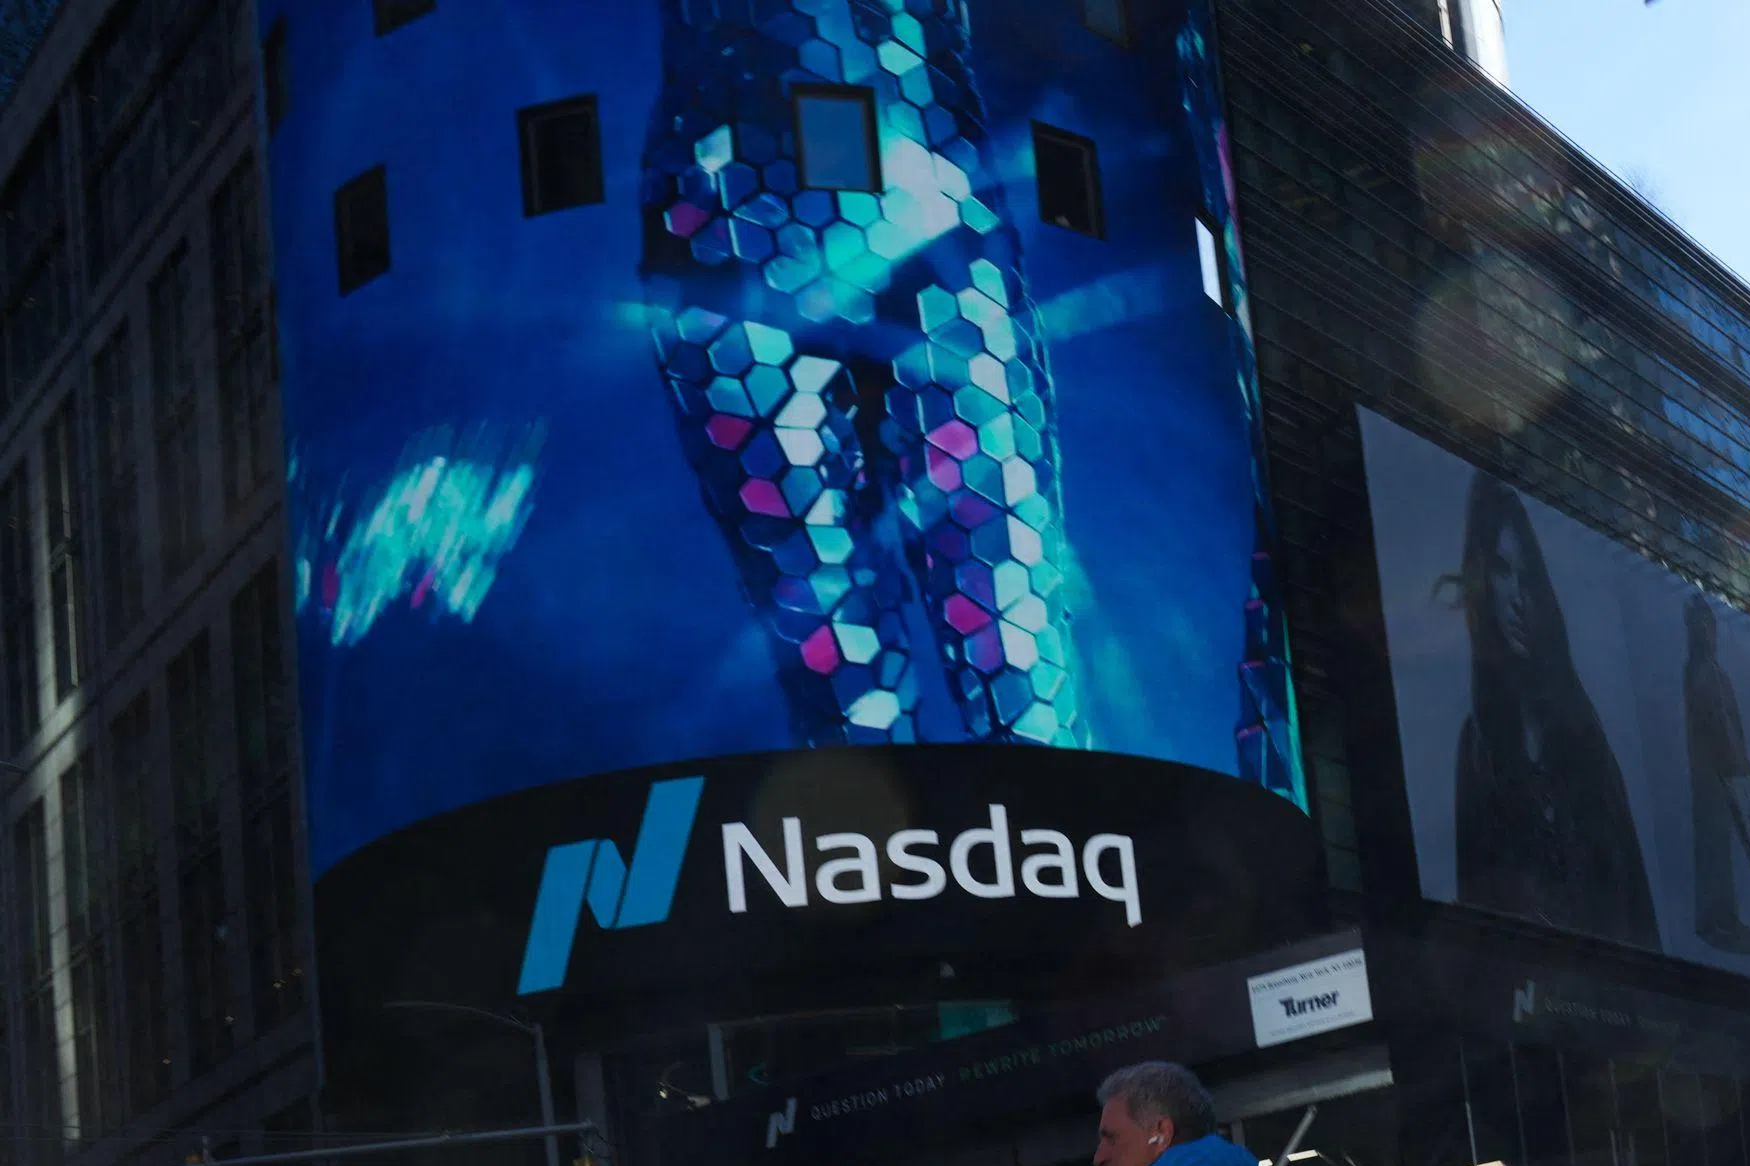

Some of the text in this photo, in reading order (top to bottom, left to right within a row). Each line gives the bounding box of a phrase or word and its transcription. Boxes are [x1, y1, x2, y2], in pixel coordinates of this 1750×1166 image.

[722, 804, 1142, 927] Nasdaq
[1279, 991, 1340, 1018] Turner
[808, 1017, 1161, 1122] QUESTION TODAY REWRITE TOMORROW
